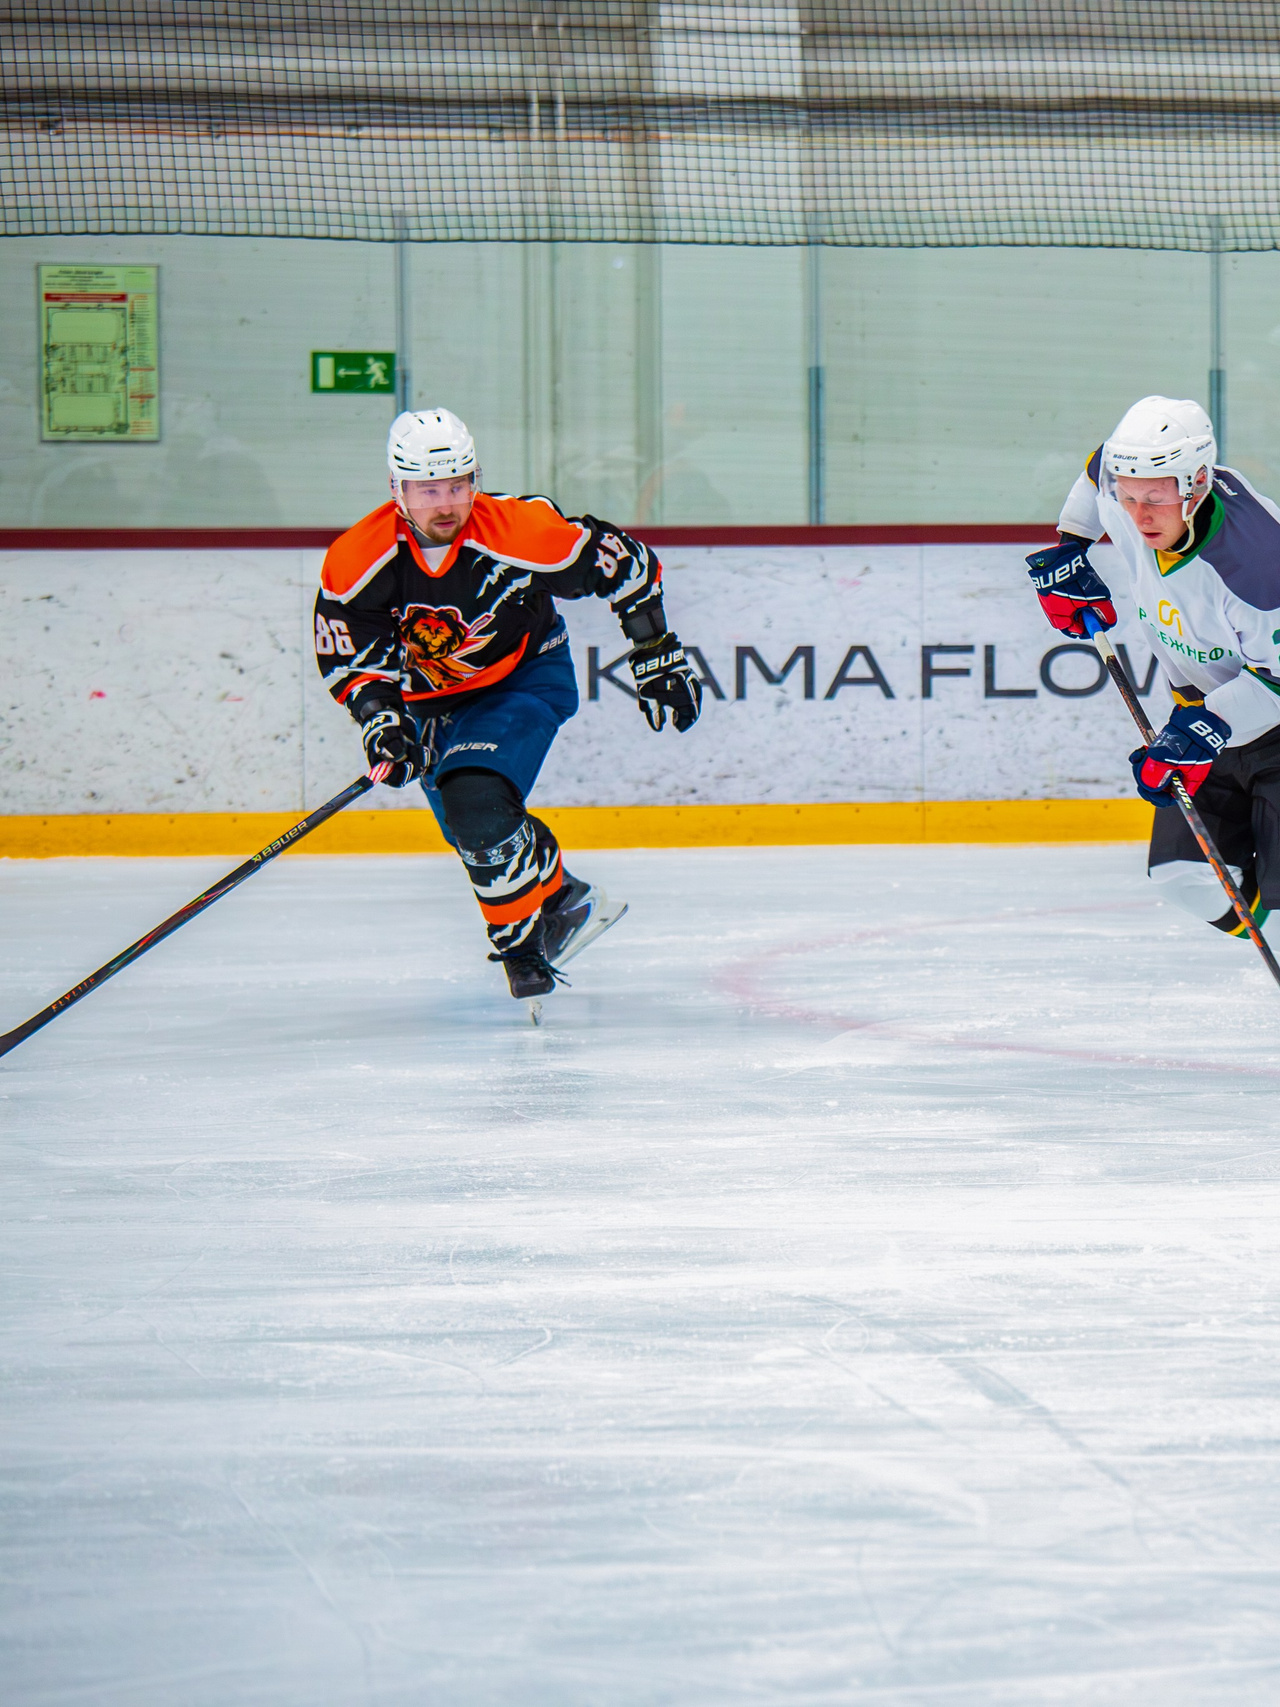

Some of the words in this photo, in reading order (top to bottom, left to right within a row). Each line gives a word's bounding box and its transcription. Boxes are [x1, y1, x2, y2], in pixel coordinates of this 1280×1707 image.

[427, 458, 456, 467] CCM
[1032, 554, 1086, 589] AUER
[316, 612, 357, 656] 86
[261, 820, 309, 858] BAUER
[51, 977, 96, 1013] FLYLITE
